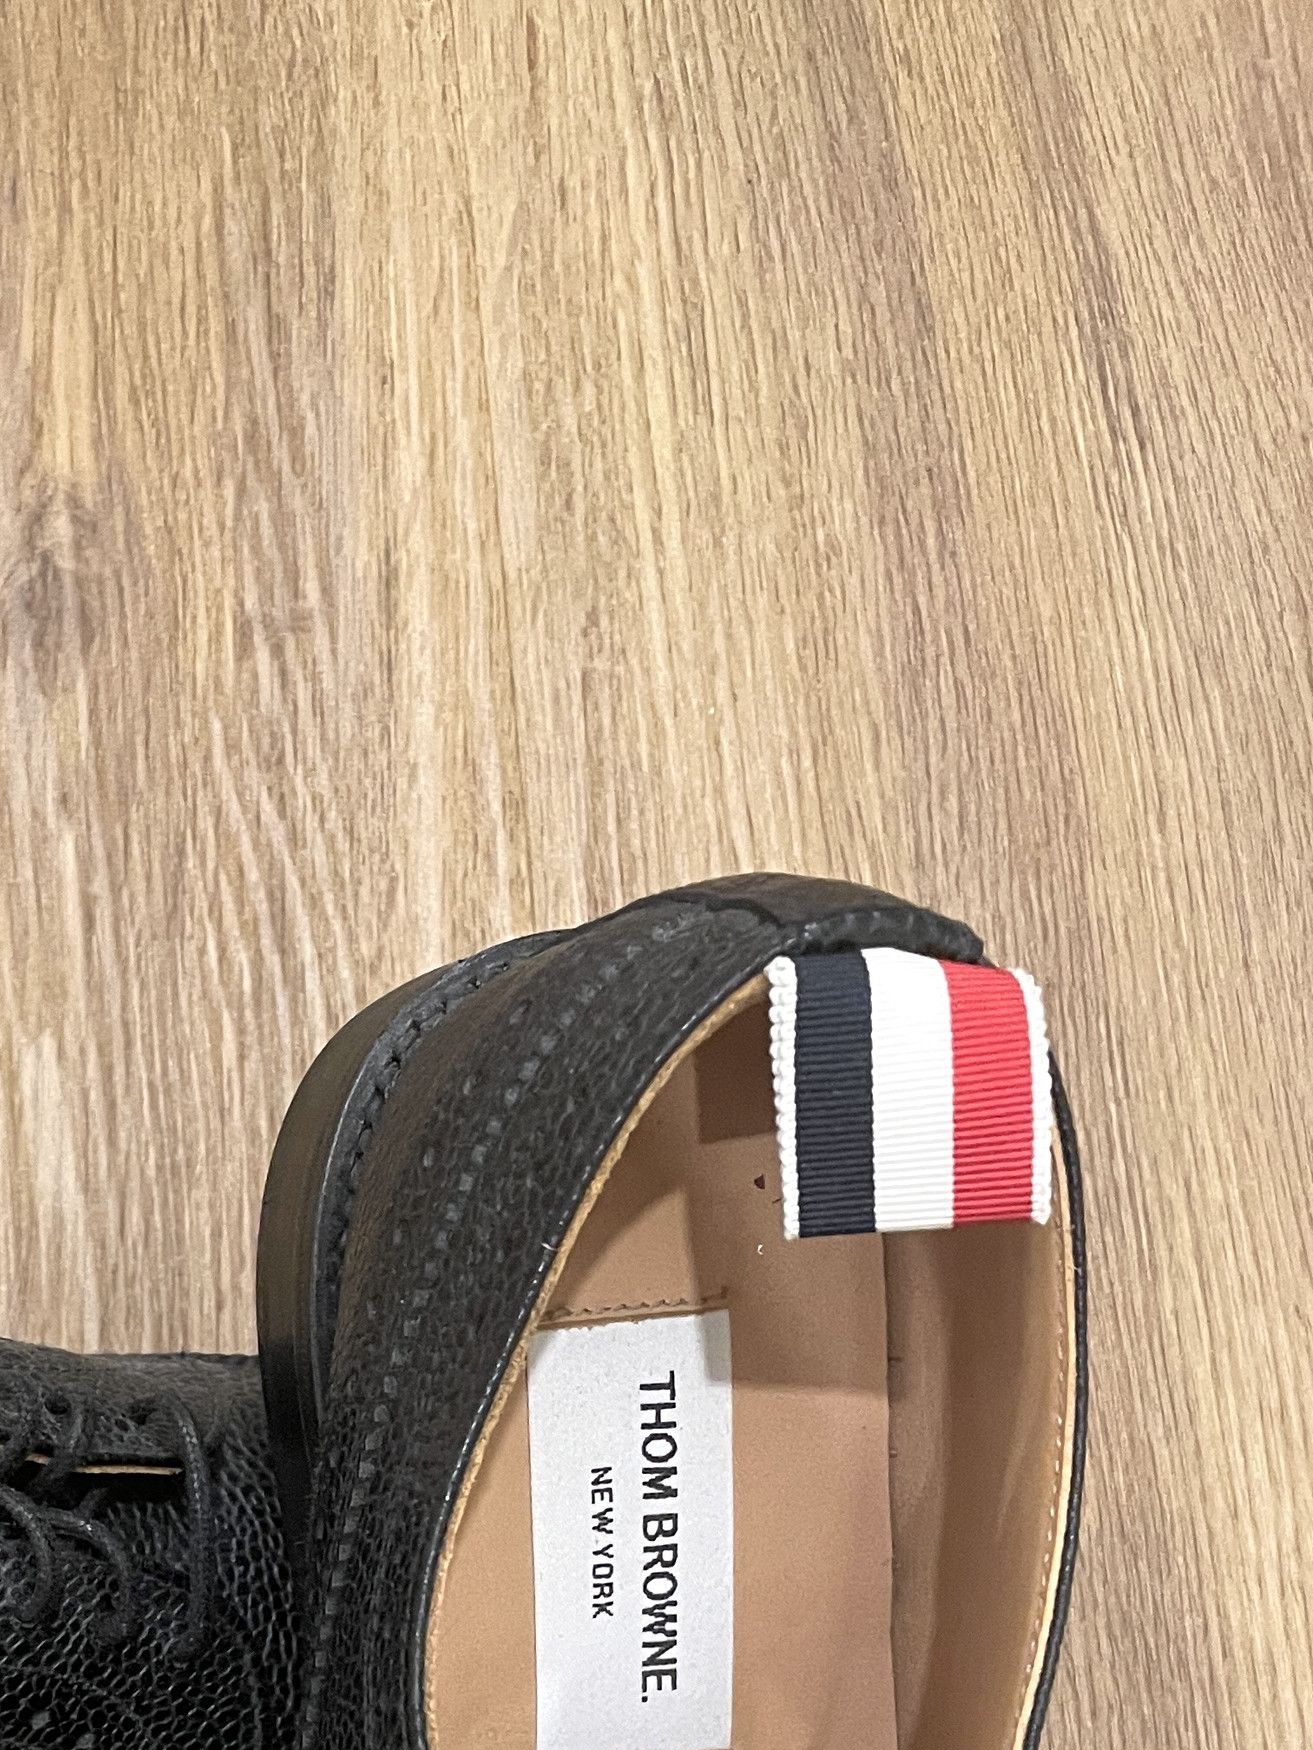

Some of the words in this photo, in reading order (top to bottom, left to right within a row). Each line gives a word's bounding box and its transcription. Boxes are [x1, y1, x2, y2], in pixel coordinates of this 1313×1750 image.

[639, 1370, 678, 1500] THOM
[591, 1466, 614, 1535] NEW
[592, 1543, 614, 1619] YORK
[641, 1512, 678, 1703] BROWNE.
